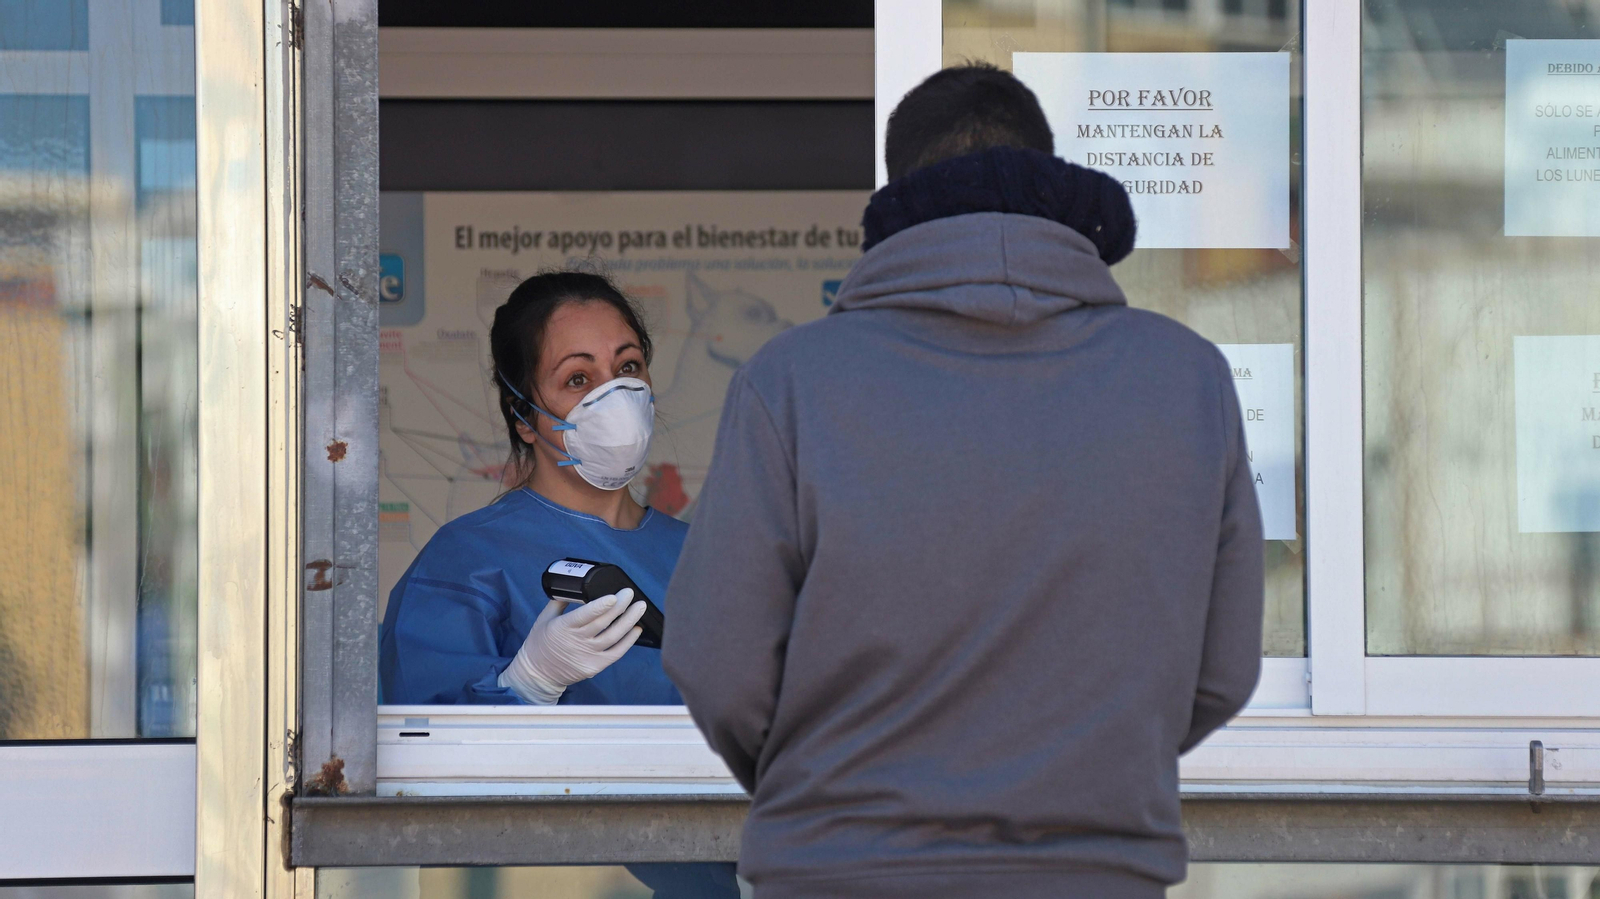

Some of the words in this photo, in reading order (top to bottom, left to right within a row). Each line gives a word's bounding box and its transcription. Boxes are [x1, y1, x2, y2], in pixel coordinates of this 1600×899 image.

[1547, 63, 1593, 74] DEBIDO
[1088, 89, 1131, 107] POR
[1137, 87, 1213, 107] FAVOR
[1535, 102, 1572, 118] SÓLO
[1575, 105, 1593, 118] SE
[1076, 124, 1193, 138] MANTENGAN
[1198, 124, 1224, 138] LA
[1086, 152, 1185, 166] DISTANCIA
[1190, 152, 1215, 166] DE
[1536, 169, 1563, 182] LOS
[1121, 180, 1203, 194] GURIDAD
[455, 226, 472, 249] El
[479, 225, 541, 255] mejor
[547, 230, 613, 254] apoyo
[618, 230, 667, 254] para
[672, 224, 692, 248] el
[697, 224, 799, 248] bienestar
[804, 224, 832, 248] de
[836, 227, 860, 248] tu
[436, 328, 478, 341] Oxalate
[1247, 409, 1264, 421] DE
